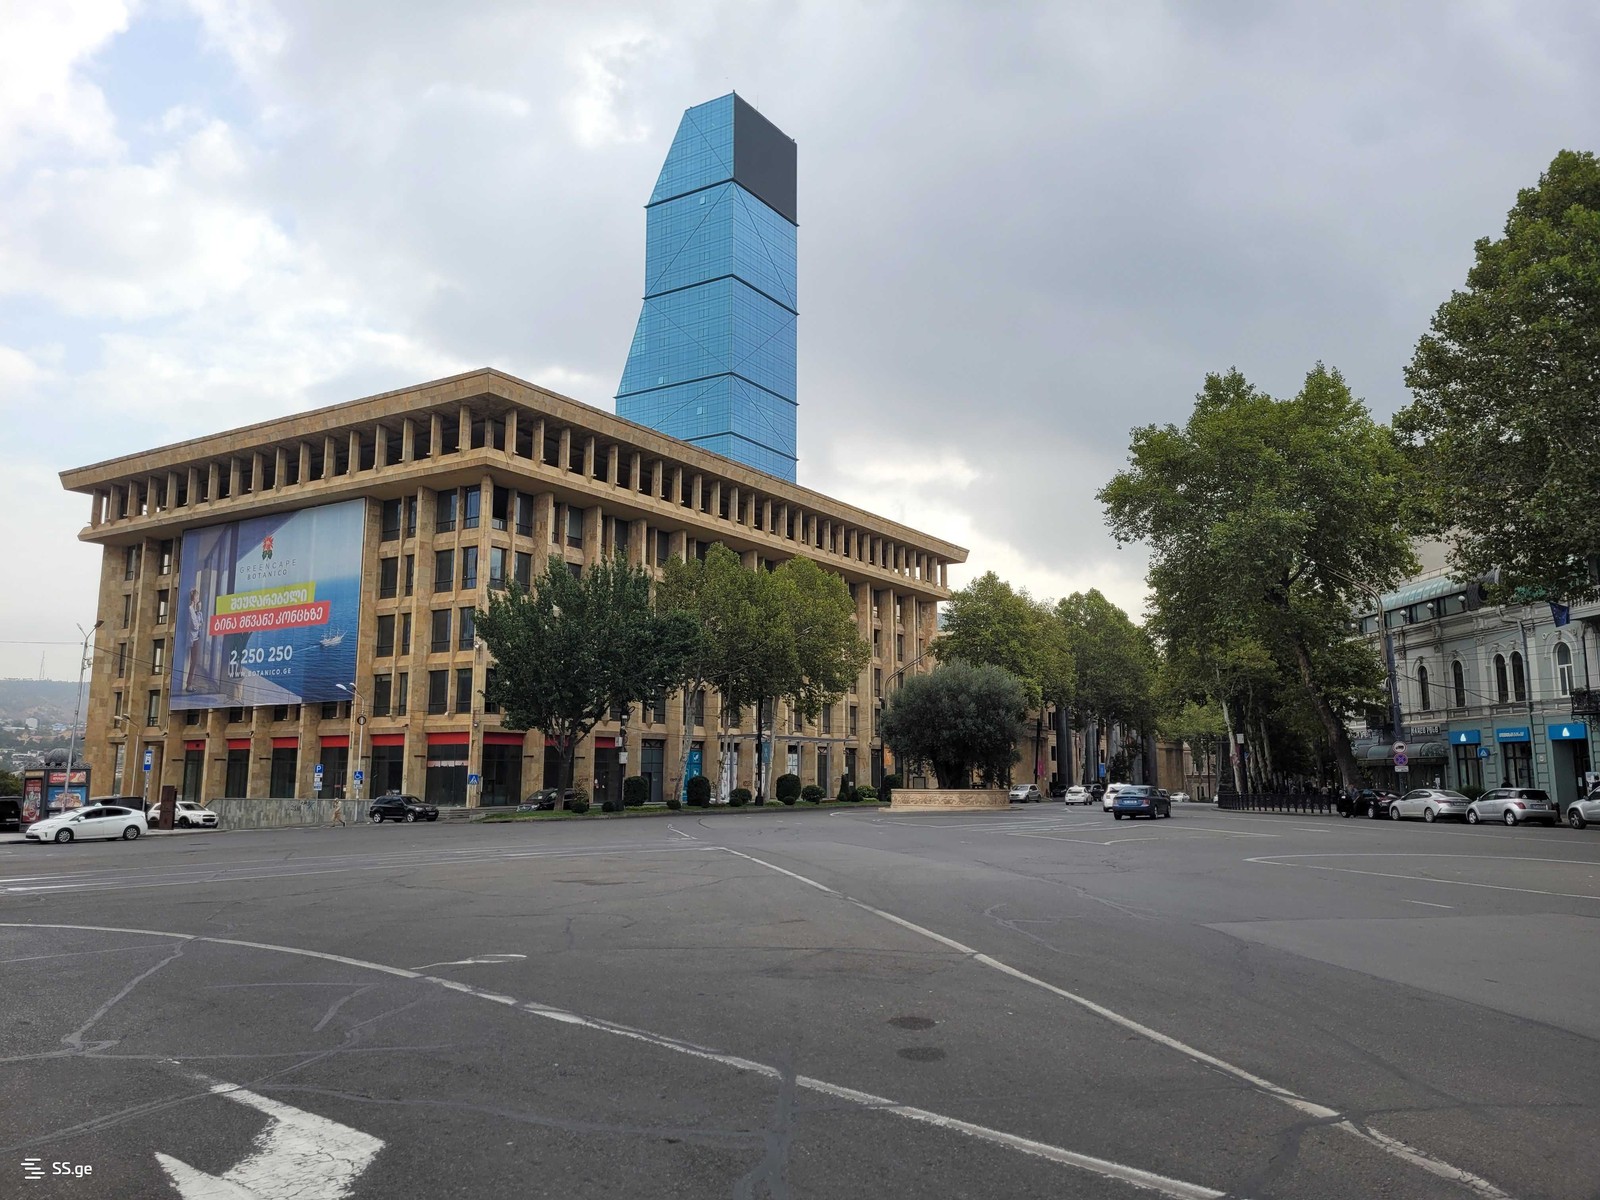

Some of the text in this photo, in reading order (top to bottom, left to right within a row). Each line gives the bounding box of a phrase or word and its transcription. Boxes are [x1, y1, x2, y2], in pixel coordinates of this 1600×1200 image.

[240, 559, 297, 574] GREENCAPE
[247, 569, 287, 580] BOTANICO
[231, 588, 307, 610] შეუდარებელი
[214, 607, 323, 631] ბინა მწვანე კონცხზე
[229, 645, 293, 665] 2 250 250
